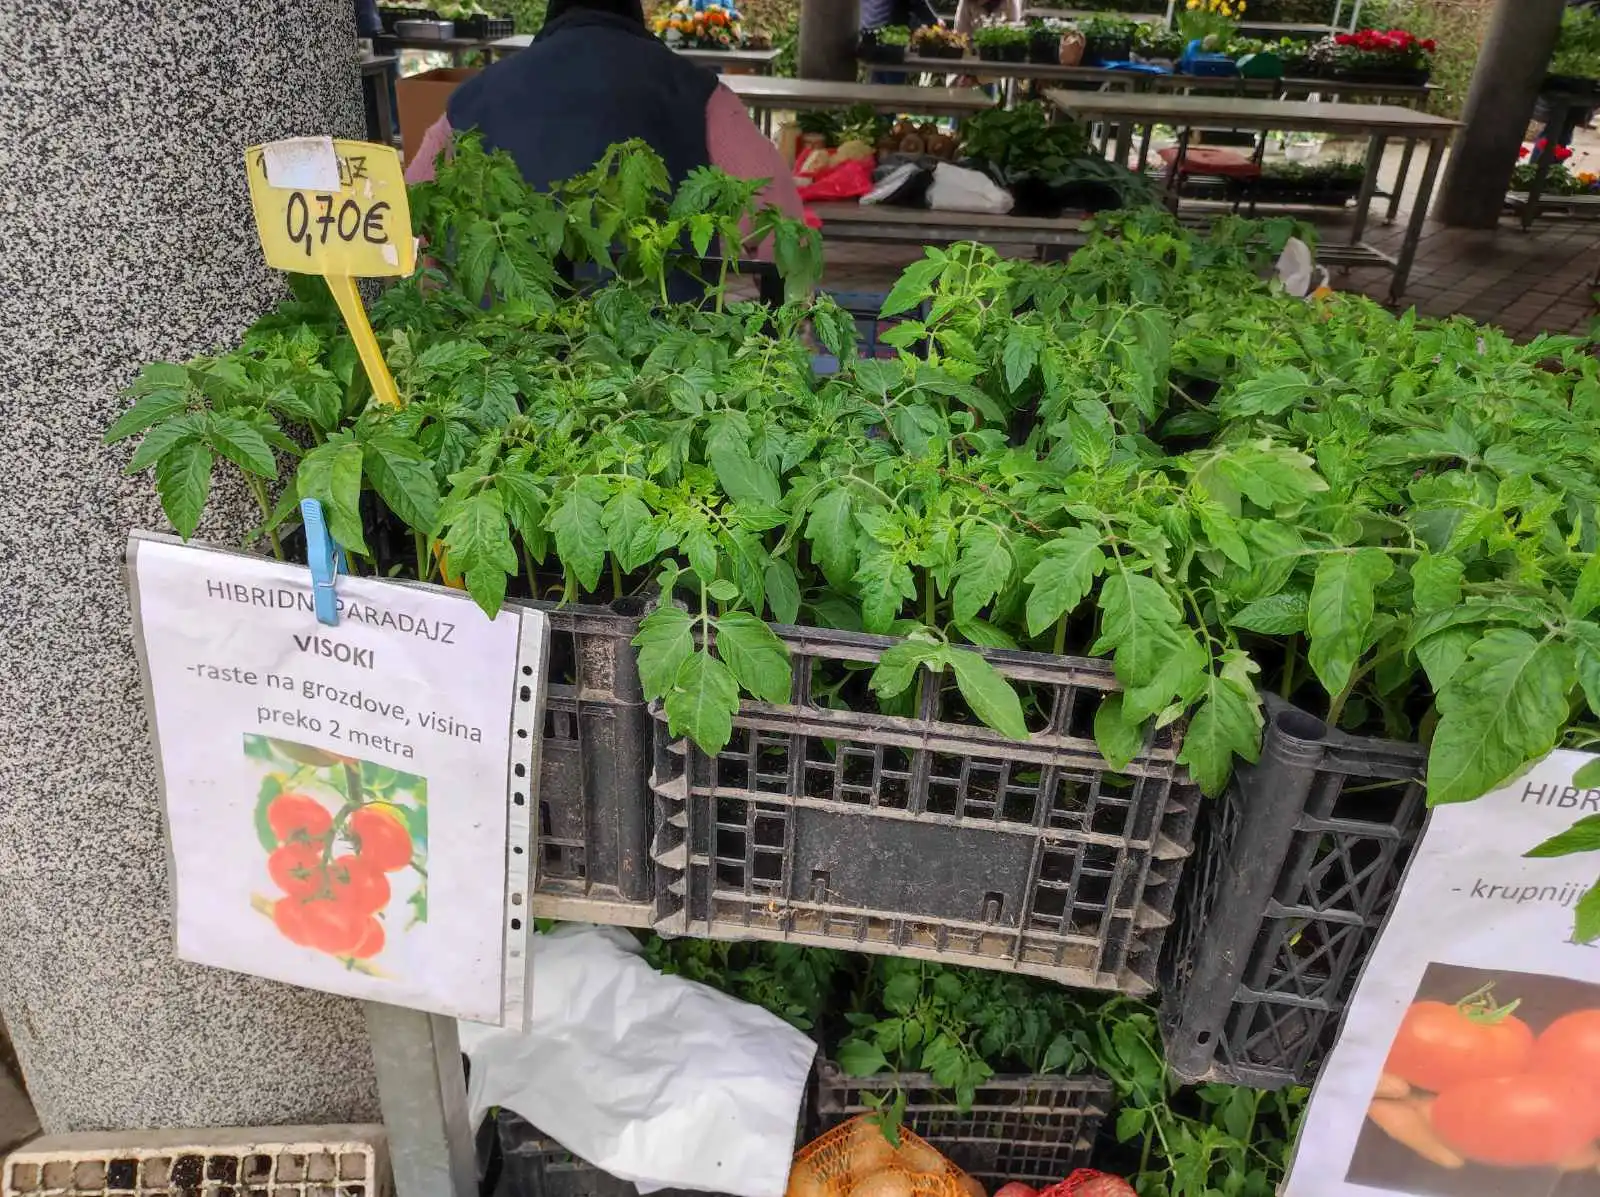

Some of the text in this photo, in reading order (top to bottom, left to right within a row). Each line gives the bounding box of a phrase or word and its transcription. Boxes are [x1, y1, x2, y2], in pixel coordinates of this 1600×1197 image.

[286, 191, 391, 257] 0,70€
[206, 579, 315, 612] HIBRIDN
[293, 634, 375, 670] VISOKI
[186, 663, 482, 743] -raste na grozdove, visina
[257, 705, 415, 759] preko 2 metra
